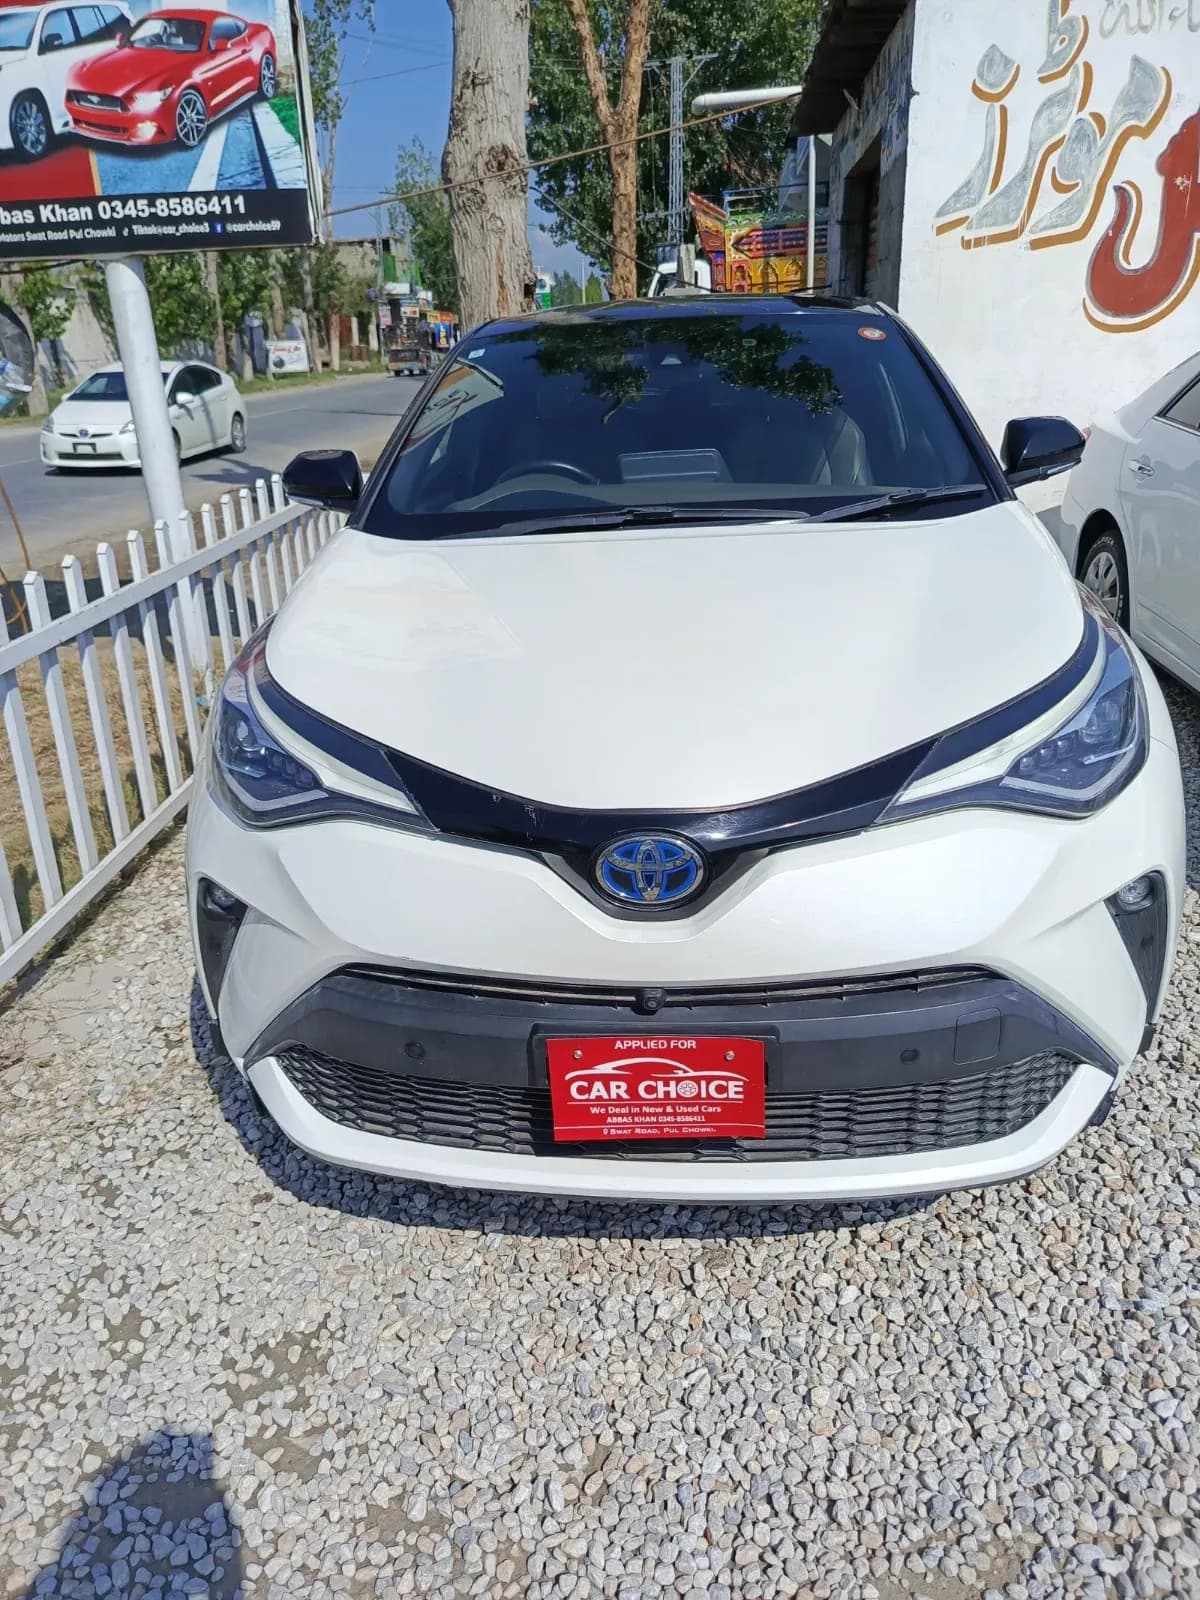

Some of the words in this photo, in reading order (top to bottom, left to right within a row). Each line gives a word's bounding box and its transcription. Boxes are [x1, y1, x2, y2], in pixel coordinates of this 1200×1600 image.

[39, 203, 94, 223] Khan
[97, 194, 246, 220] 0345-8586411
[26, 230, 47, 242] Swat
[47, 229, 69, 240] Road
[69, 228, 84, 239] Pul
[84, 225, 116, 238] Chowki
[614, 1039, 668, 1050] APPLIED
[670, 1039, 697, 1050] FOR
[569, 1080, 630, 1101] CAR
[637, 1079, 745, 1100] CHOICE
[590, 1106, 607, 1115] We
[608, 1105, 629, 1114] Deal
[642, 1105, 665, 1114] New
[666, 1105, 674, 1113] &
[676, 1104, 700, 1113] Used
[701, 1104, 722, 1113] Cars
[606, 1116, 633, 1124] ABBAS
[658, 1115, 706, 1123] 0345-8586411
